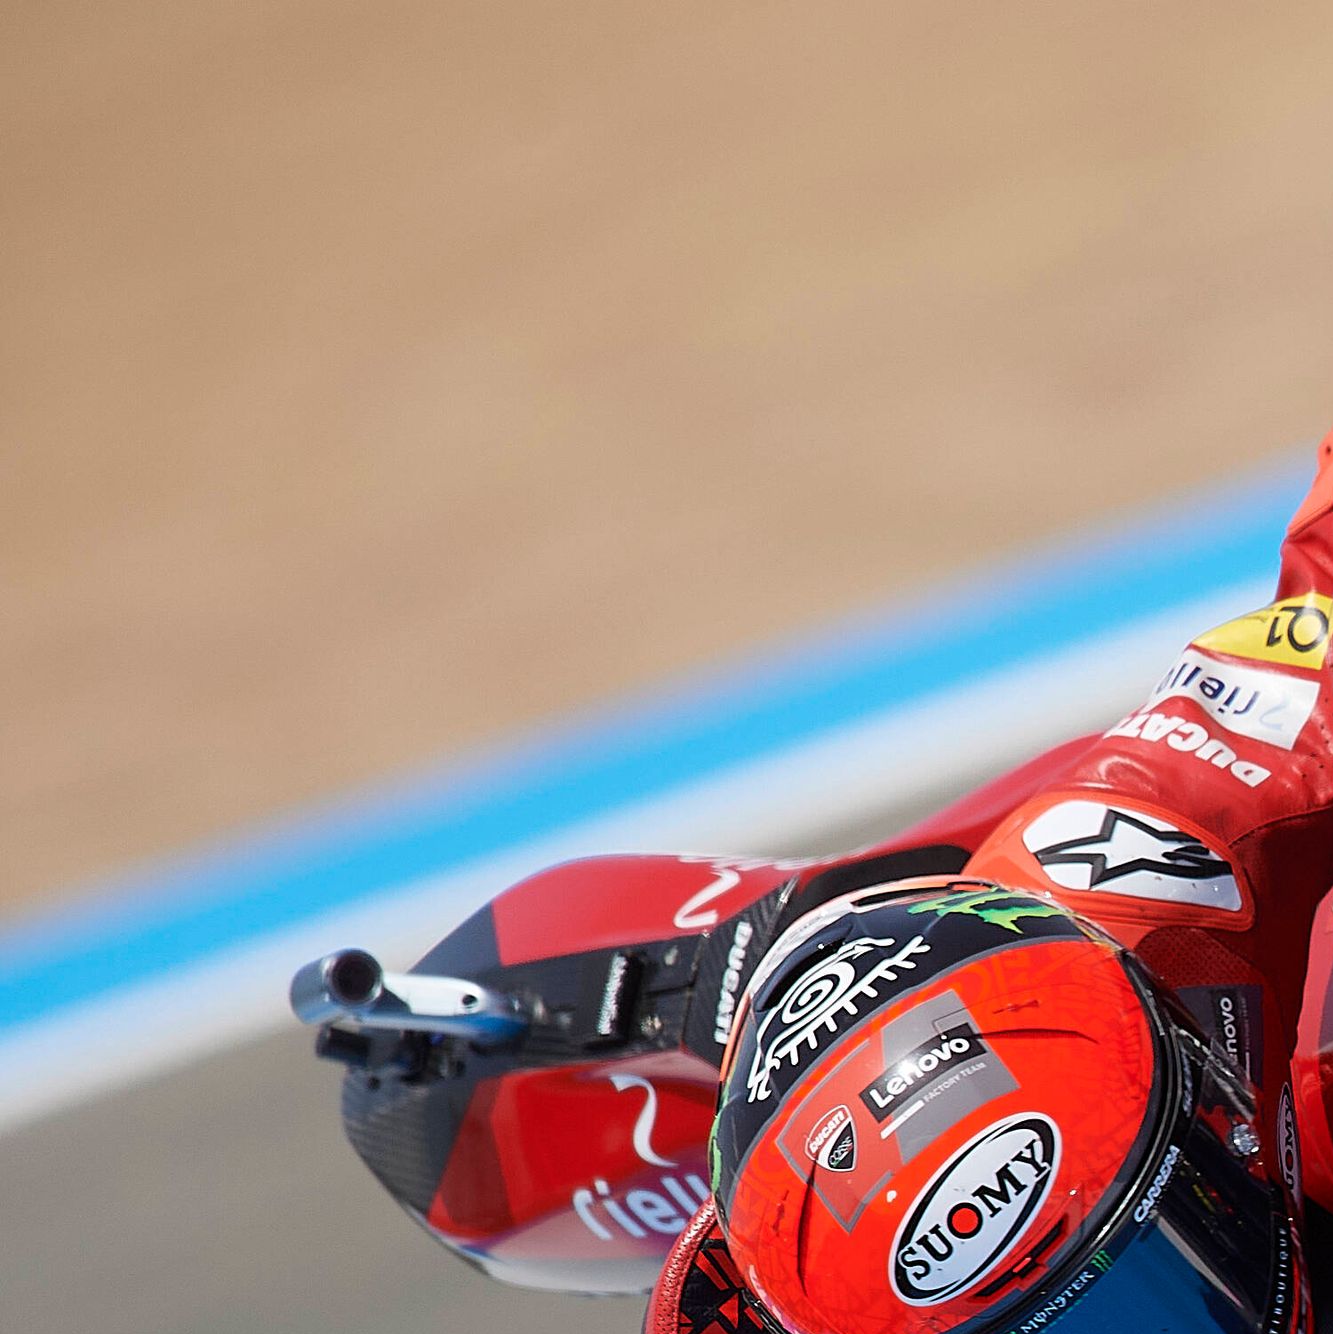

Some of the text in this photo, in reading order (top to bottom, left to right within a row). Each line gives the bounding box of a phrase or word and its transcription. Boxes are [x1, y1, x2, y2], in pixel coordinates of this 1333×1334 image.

[870, 1036, 971, 1109] Lenovo
[923, 1074, 961, 1103] FACTORY
[809, 1112, 845, 1154] DUCATI
[898, 1137, 1053, 1281] SUOMY
[1134, 1145, 1181, 1223] CARRERA
